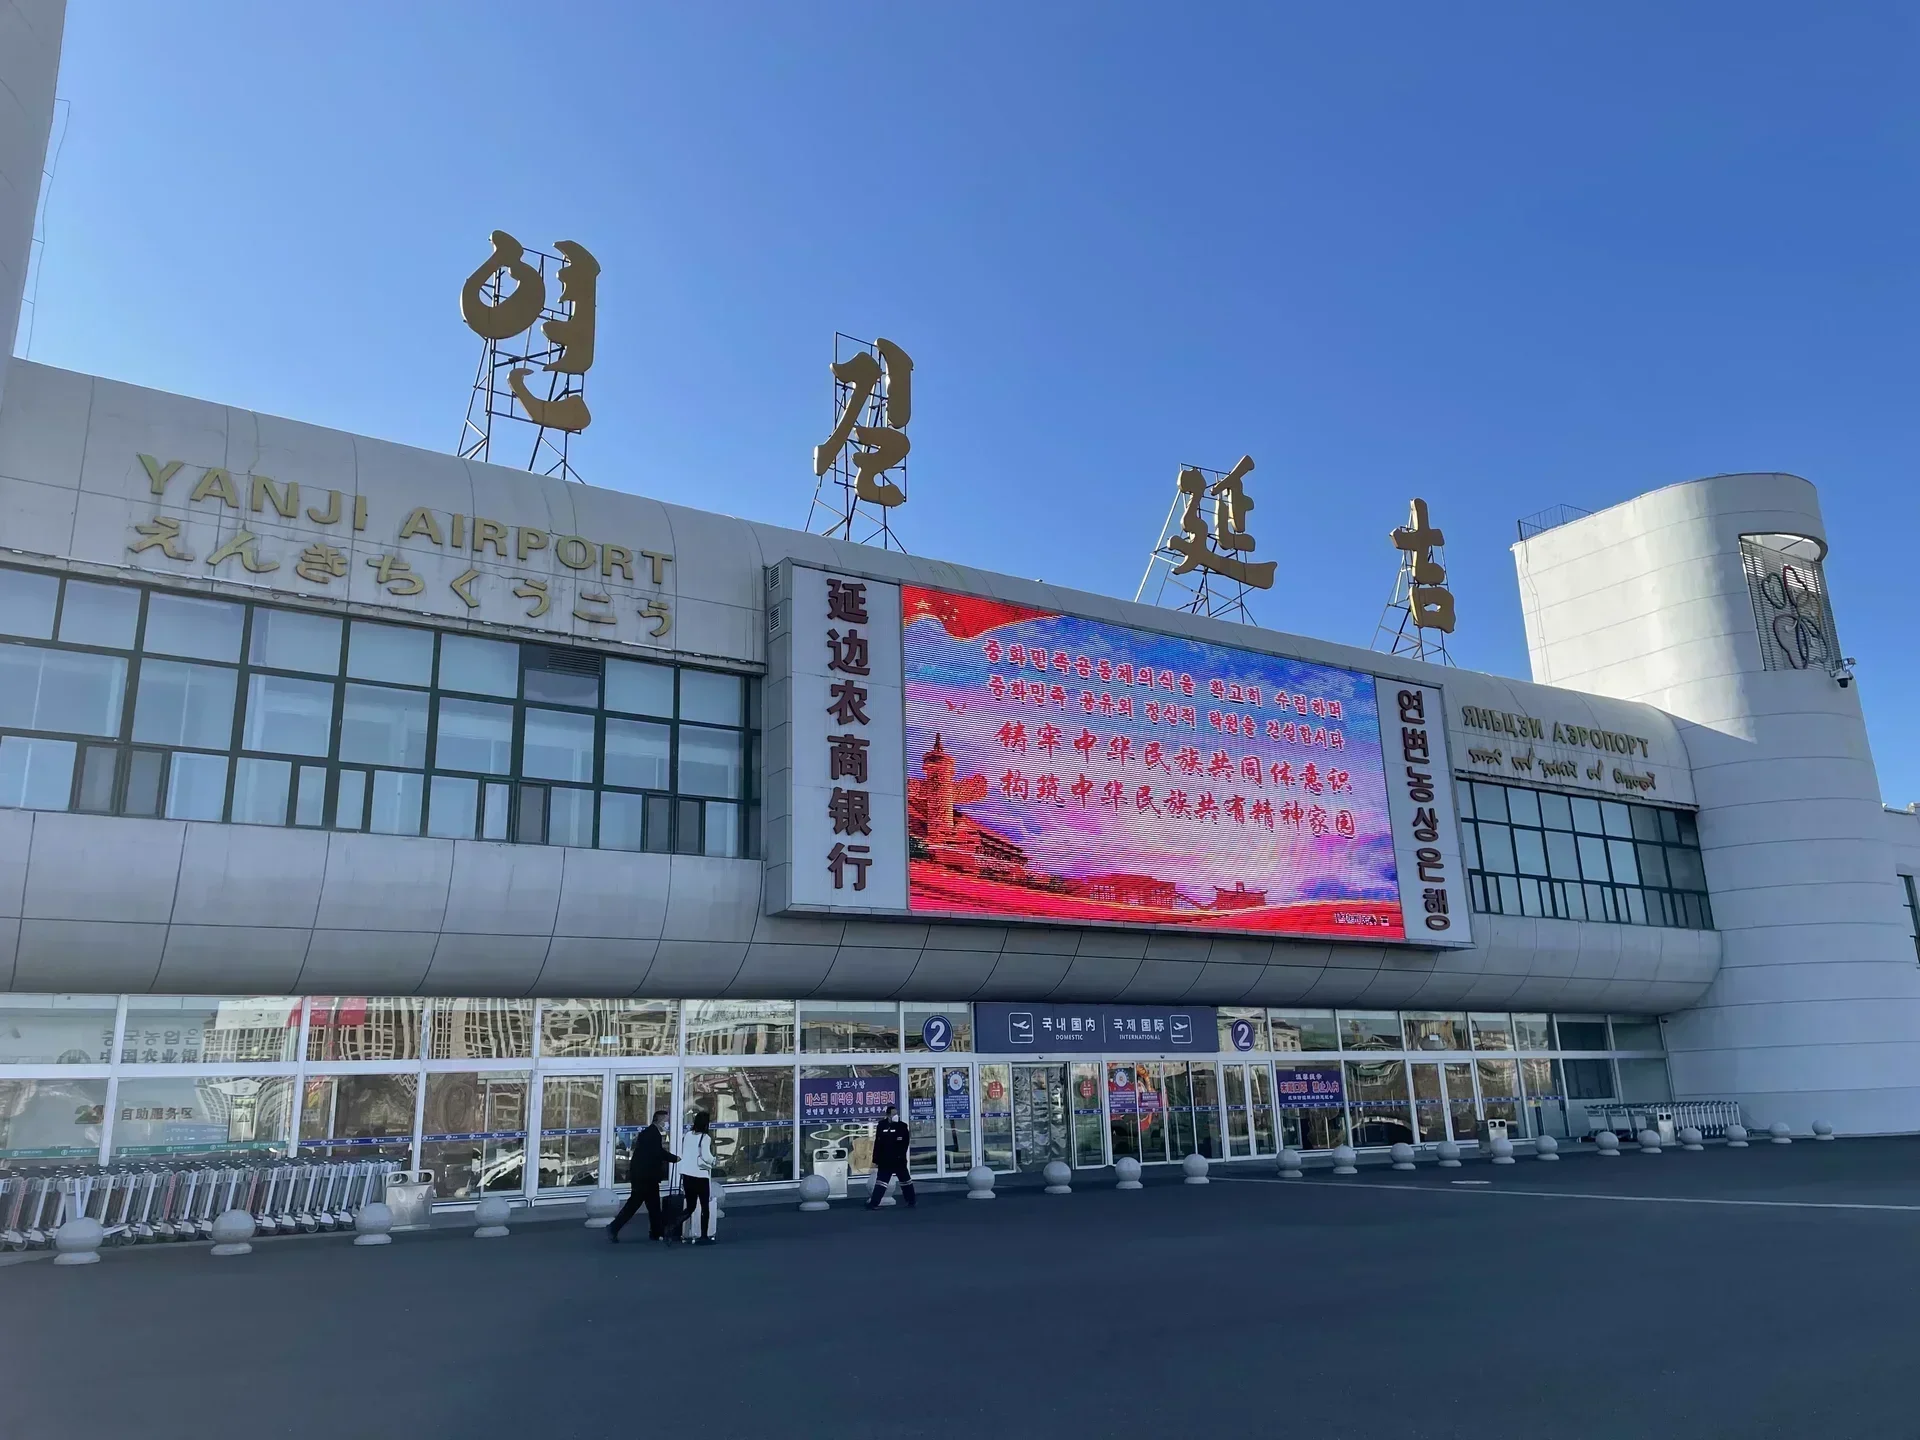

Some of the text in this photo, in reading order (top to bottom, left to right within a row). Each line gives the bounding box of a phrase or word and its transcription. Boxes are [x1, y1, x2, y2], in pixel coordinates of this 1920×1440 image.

[137, 453, 674, 585] YANJI AIRPORT
[128, 516, 674, 638] えんきちくうこう
[983, 639, 1343, 721] 중화민족공동체의식을 확고히 수립하며
[988, 674, 1068, 710] 중화민족
[1145, 701, 1196, 729] 정신적
[1266, 720, 1345, 752] 건설합시다
[827, 578, 872, 891] 延边农商银行
[1553, 721, 1649, 758] АЭРОПОРТ
[996, 720, 1353, 795] 铸牢中华民族共同体意识
[1000, 768, 1355, 838] 构筑中华民族共有精神家园
[1397, 689, 1450, 931] 연변농상은행
[101, 1028, 200, 1046] 중국농업은
[930, 1020, 946, 1047] 2
[1042, 1017, 1096, 1032] 국내 国内
[1113, 1018, 1165, 1032] 국제 国际
[1238, 1023, 1251, 1048] 2
[804, 1092, 828, 1107] 마스크
[855, 1091, 864, 1105] 시
[866, 1091, 895, 1105] 출입금지
[835, 1080, 866, 1089] 참고사항
[121, 1106, 193, 1121] 自助服务区
